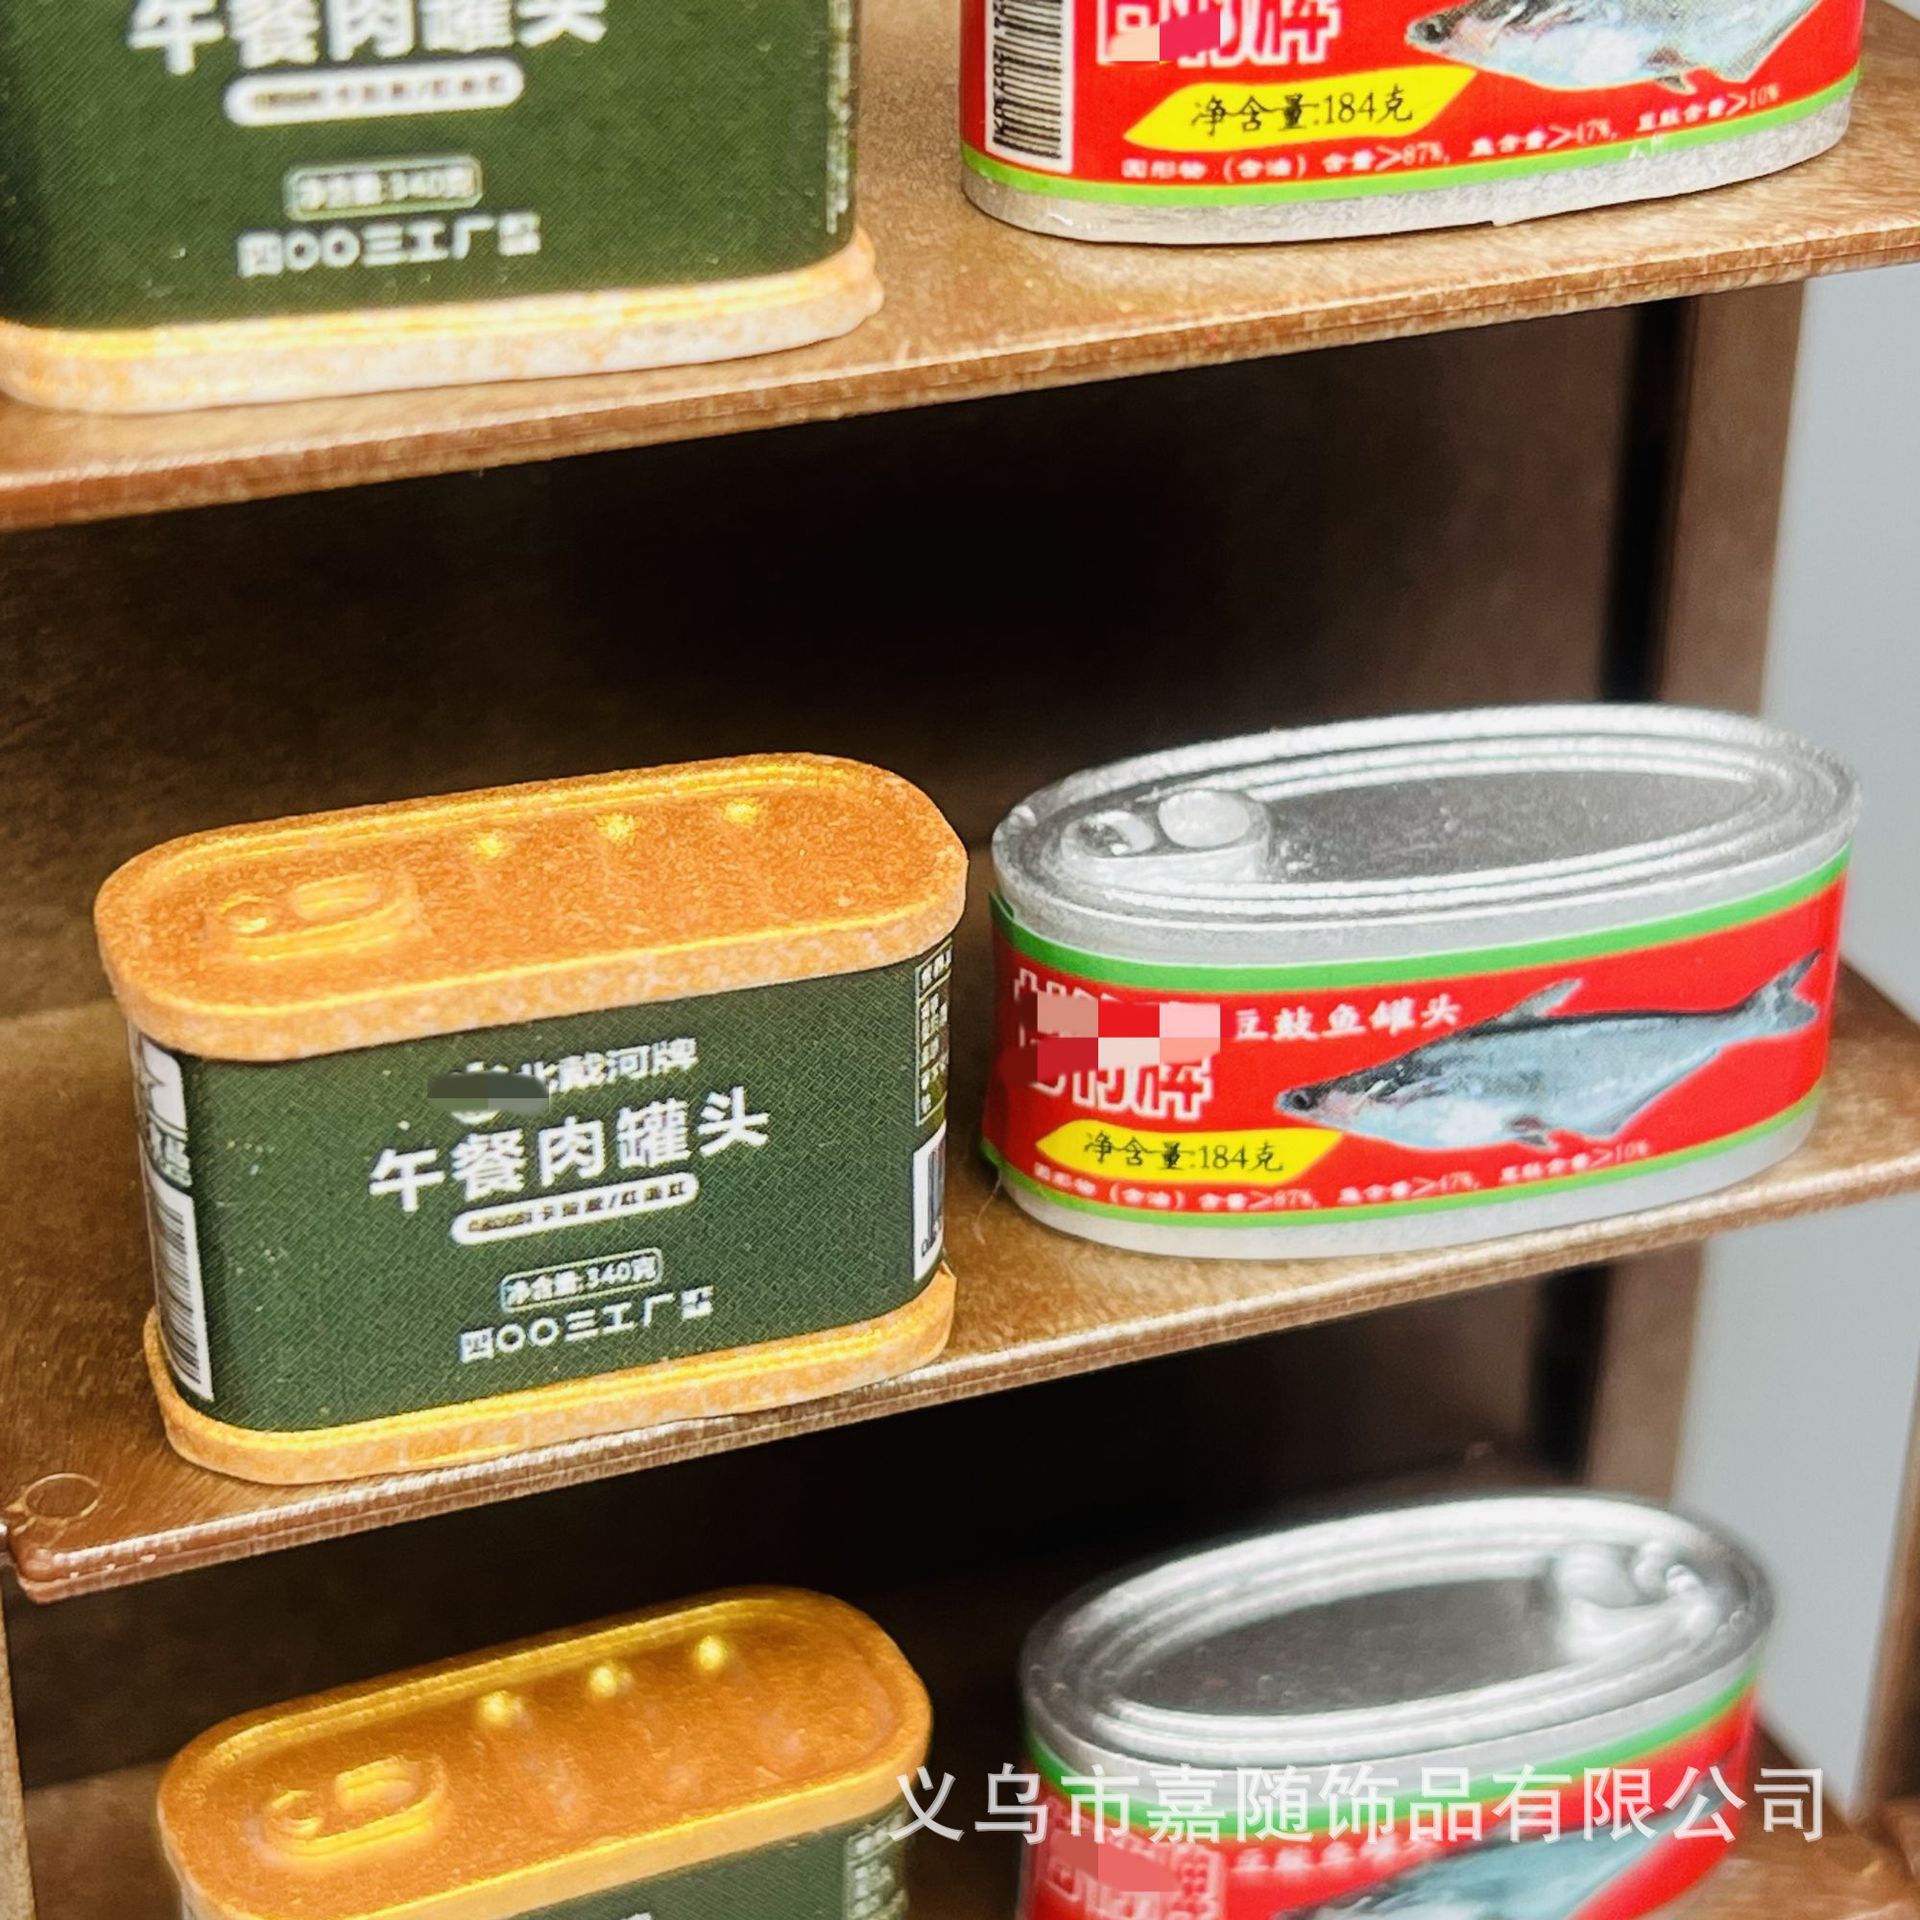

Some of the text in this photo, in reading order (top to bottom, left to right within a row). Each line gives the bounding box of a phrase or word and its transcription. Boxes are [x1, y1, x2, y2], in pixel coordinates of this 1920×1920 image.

[368, 1086, 770, 1212] 午餐肉罐头
